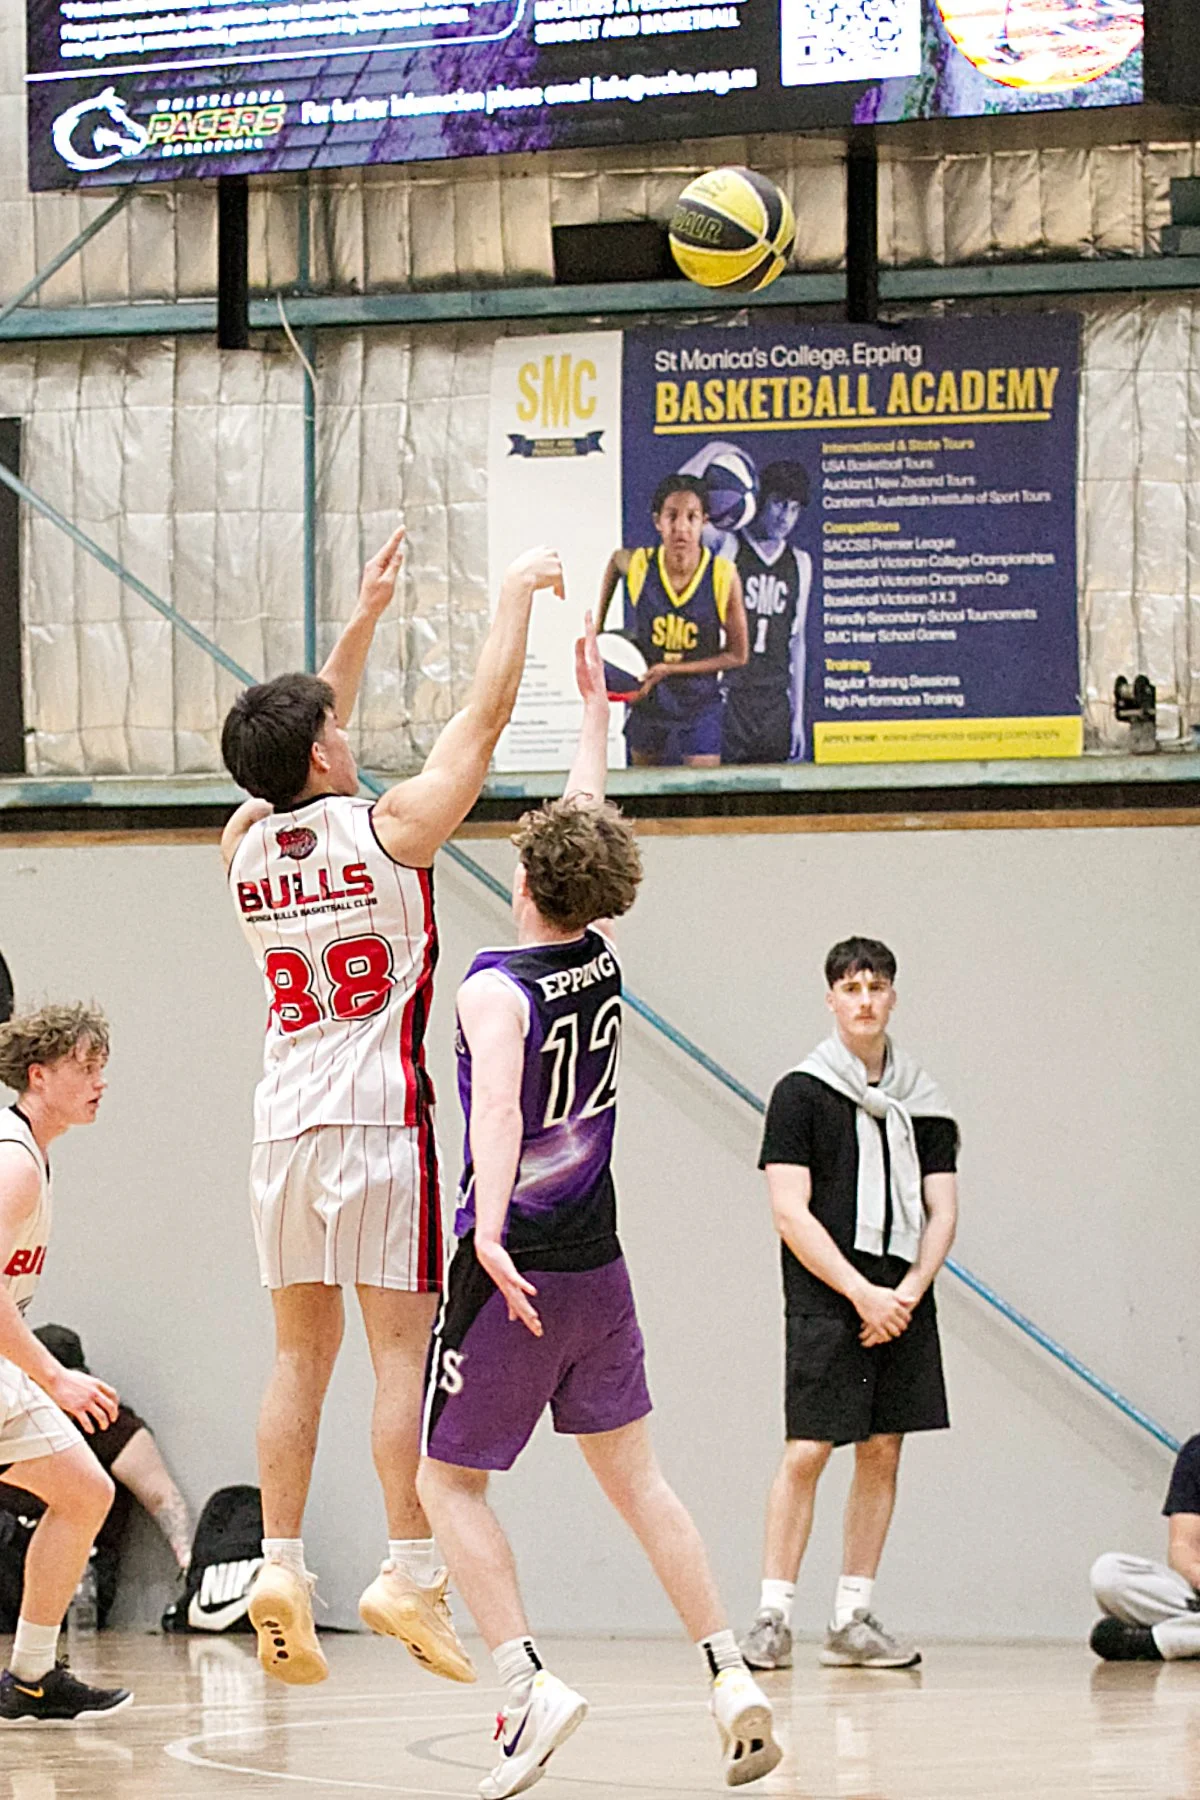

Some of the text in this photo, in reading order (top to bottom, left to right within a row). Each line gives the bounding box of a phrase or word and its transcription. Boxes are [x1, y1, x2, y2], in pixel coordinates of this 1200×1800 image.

[601, 15, 640, 39] AND
[641, 6, 741, 35] BASKETBALL
[301, 101, 330, 125] For
[331, 96, 388, 122] further
[390, 87, 486, 117] information
[486, 84, 543, 115] please
[544, 76, 591, 105] email
[147, 103, 288, 146] PACERS
[655, 342, 922, 371] St Monica's College, Epping
[516, 353, 597, 428] SMC
[655, 367, 1059, 424] BASKETBALL ACADEMY
[822, 442, 895, 454] International
[908, 439, 941, 452] State
[943, 437, 975, 450] Tours
[822, 457, 934, 473] USA Basketball Tours
[874, 476, 899, 489] New
[901, 475, 943, 488] Zealand
[946, 474, 976, 486] Tours
[877, 494, 930, 507] Australian
[931, 493, 975, 505] Institute
[976, 492, 987, 504] of
[990, 491, 1019, 504] Sport
[1021, 489, 1051, 502] Tours
[822, 521, 900, 535] Competitions
[873, 538, 914, 551] Premier
[915, 537, 956, 551] League
[823, 553, 1055, 570] Basketball Victorian College Championships
[823, 573, 1009, 589] Basketball Victorian Champion Cup
[745, 573, 788, 617] SMC
[823, 593, 879, 607] Basketball
[880, 592, 927, 605] Victorian
[928, 592, 936, 604] 3
[947, 591, 956, 603] 3
[823, 608, 1037, 626] Friendly Secondary School Tournaments
[652, 613, 698, 650] SMC
[753, 618, 768, 653] 1
[824, 628, 957, 644] SMC Inter School Games
[824, 657, 871, 673] Training
[824, 674, 960, 691] Regular Training Sessions
[824, 692, 964, 710] High Performance Training
[237, 862, 375, 914] BULLS
[274, 909, 298, 921] BULLS
[300, 902, 352, 917] BASKETBALL
[354, 897, 378, 908] CLUB
[264, 932, 396, 1035] 88
[536, 952, 615, 1001] EPPING
[540, 995, 621, 1129] 12
